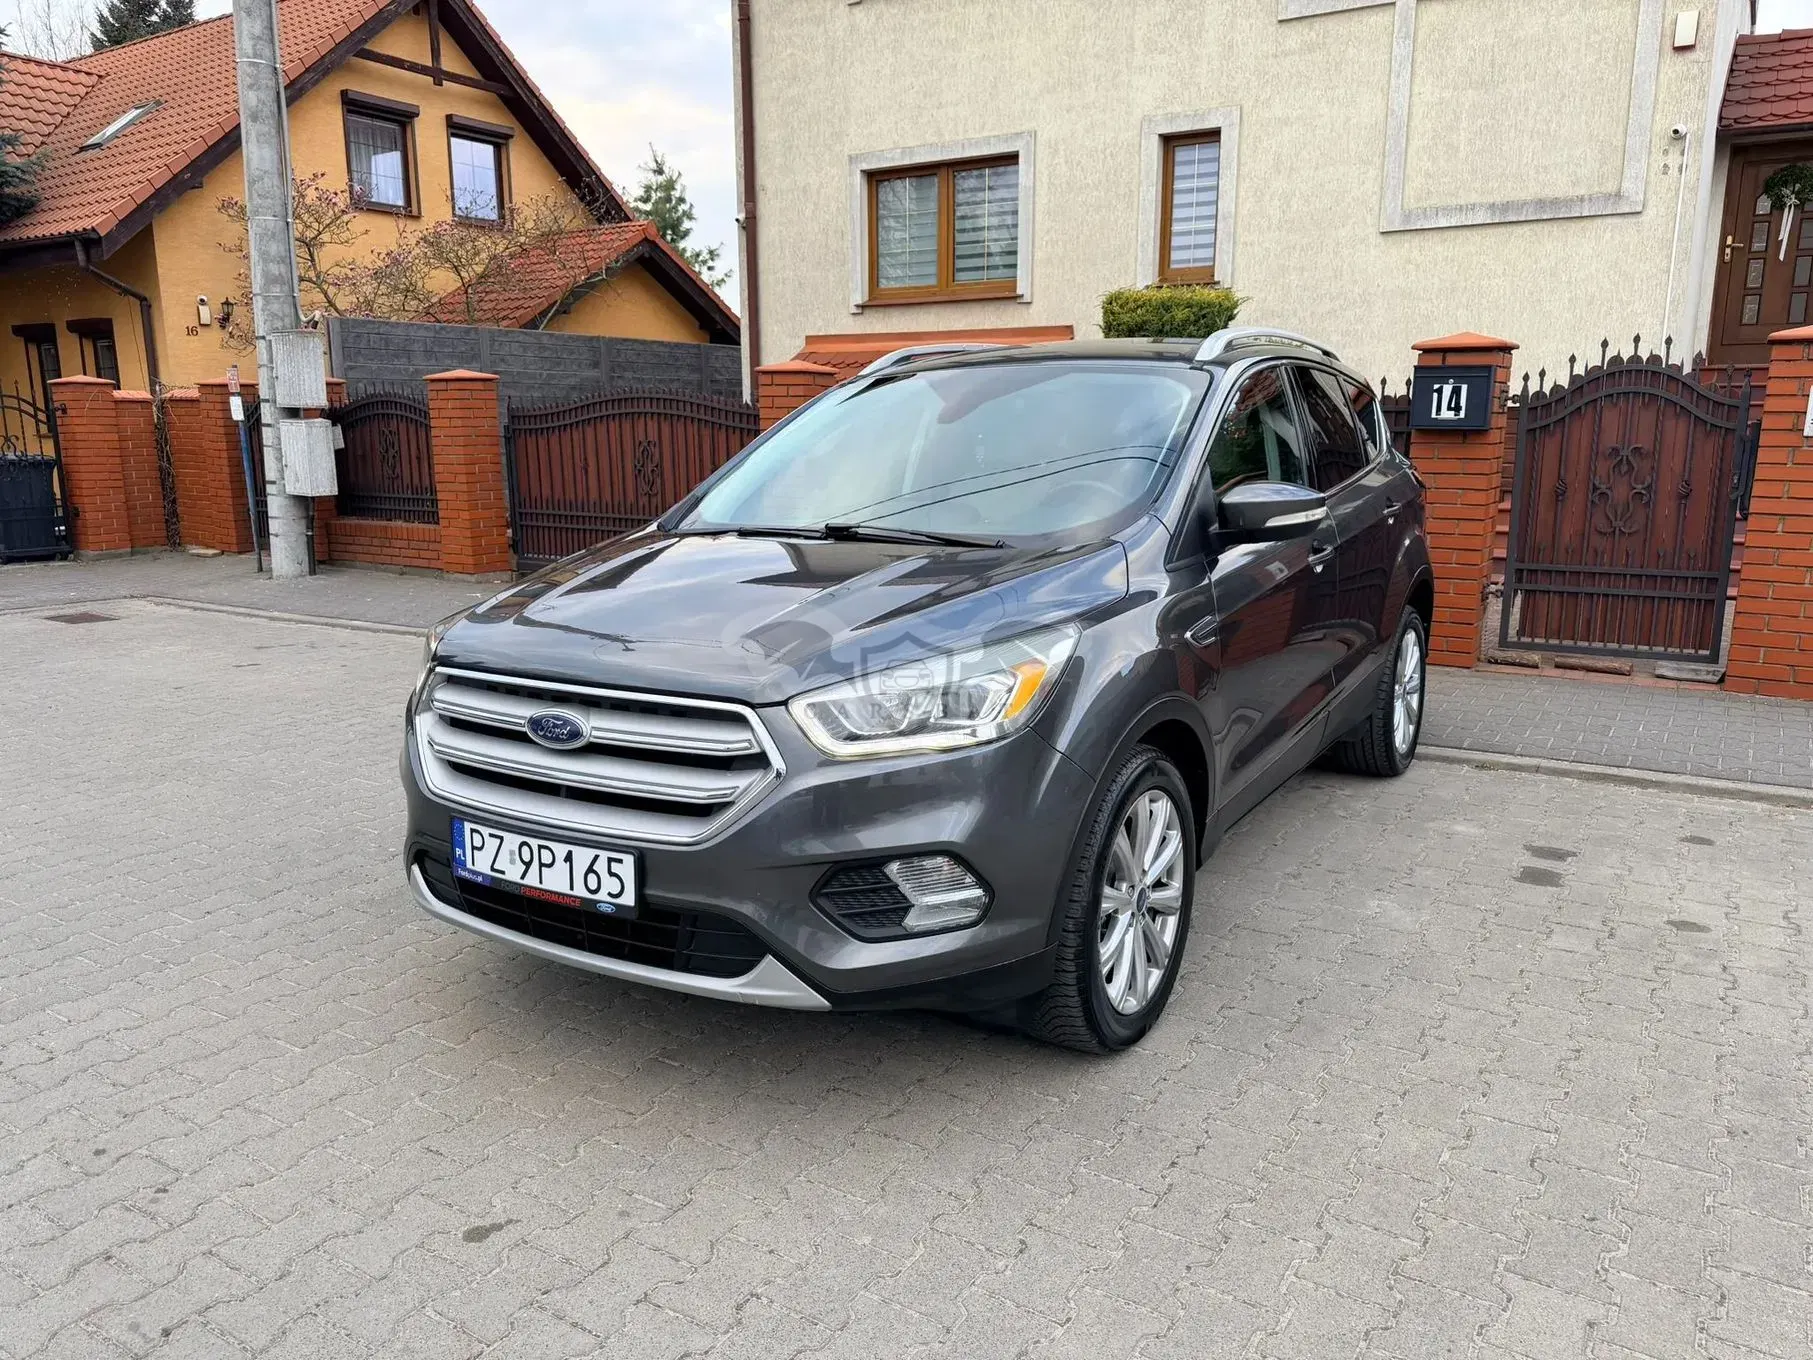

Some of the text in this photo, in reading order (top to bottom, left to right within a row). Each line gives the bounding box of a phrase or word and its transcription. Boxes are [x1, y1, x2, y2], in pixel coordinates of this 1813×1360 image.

[186, 325, 198, 336] 16
[1433, 385, 1463, 417] 14
[537, 717, 571, 739] Ford
[456, 847, 466, 860] PL
[518, 840, 626, 899] 9P165
[521, 886, 581, 906] PERFORMANCE
